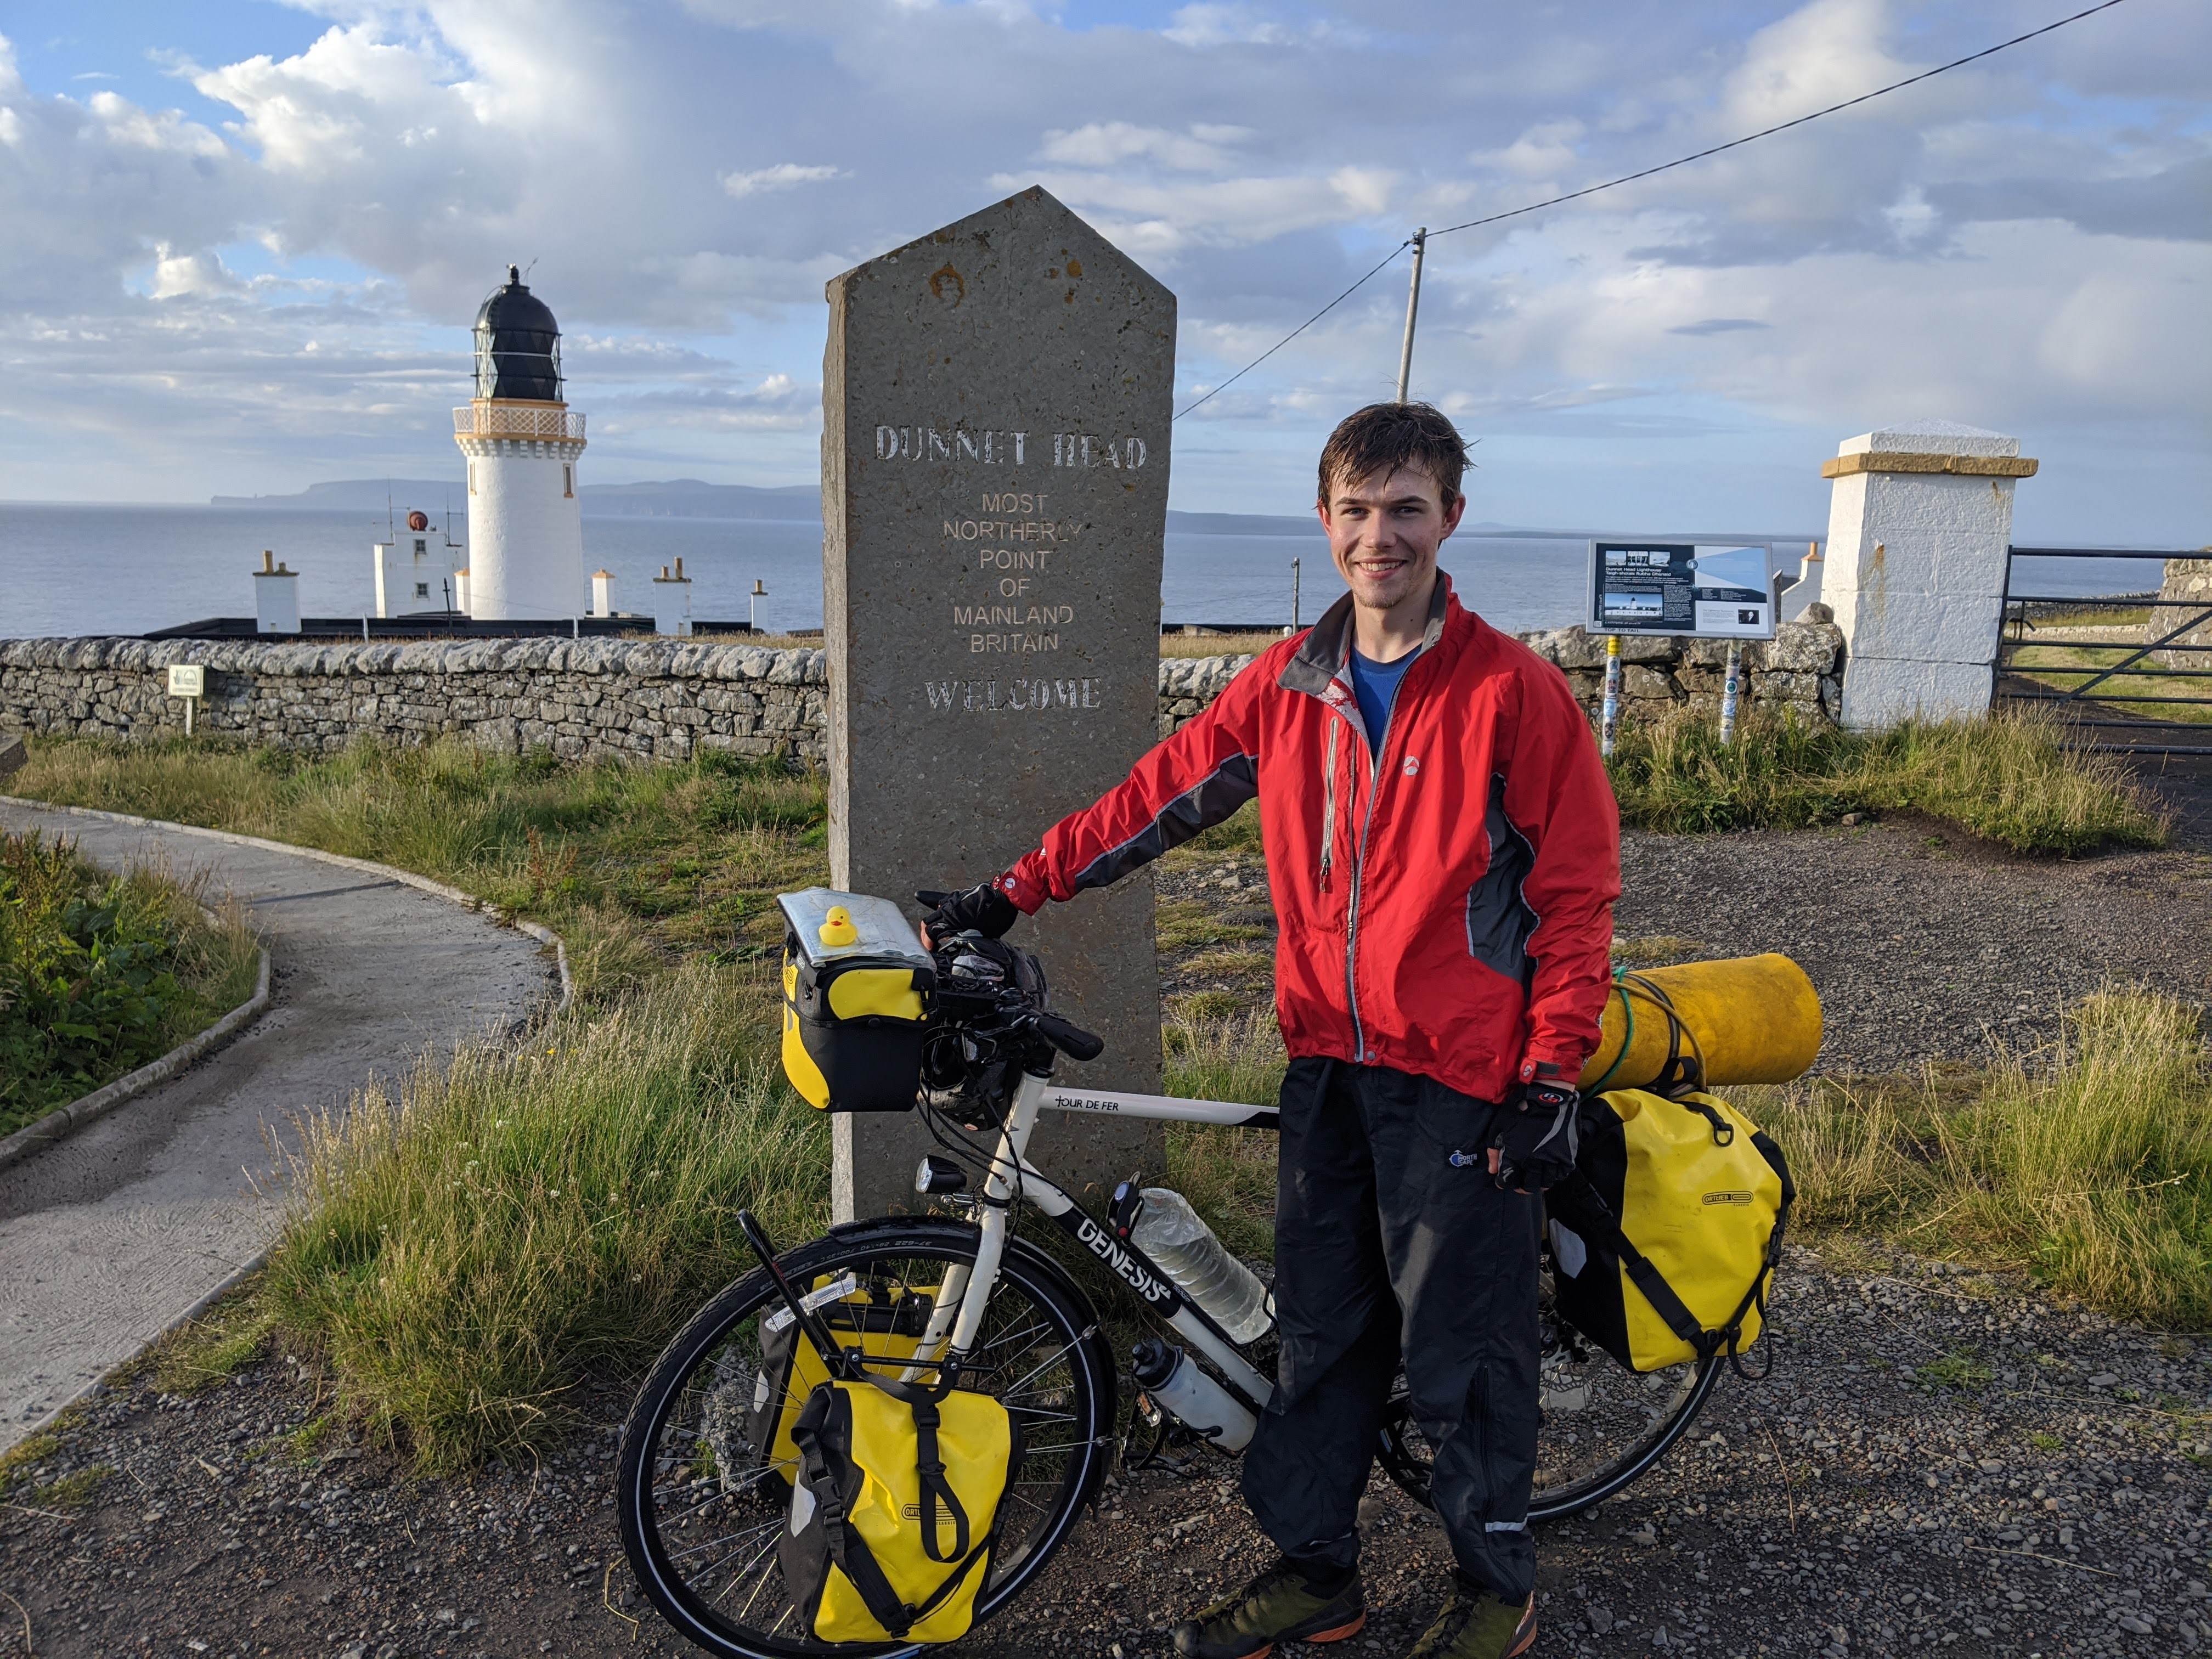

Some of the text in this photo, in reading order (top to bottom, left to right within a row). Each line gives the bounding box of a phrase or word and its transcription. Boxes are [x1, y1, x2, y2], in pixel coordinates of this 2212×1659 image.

[876, 425, 1147, 469] DUNNET HEAD
[982, 493, 1048, 513] MOST
[944, 520, 1082, 541] NORTHERLY
[980, 550, 1052, 569] POINT
[1000, 578, 1031, 597] OF
[953, 606, 1074, 624] MAINLAND
[970, 634, 1059, 652] BRITAIN
[924, 678, 1102, 712] WELCOME
[1086, 1099, 1099, 1109] DE
[1102, 1101, 1119, 1111] FER
[1077, 1218, 1161, 1301] GENESIS
